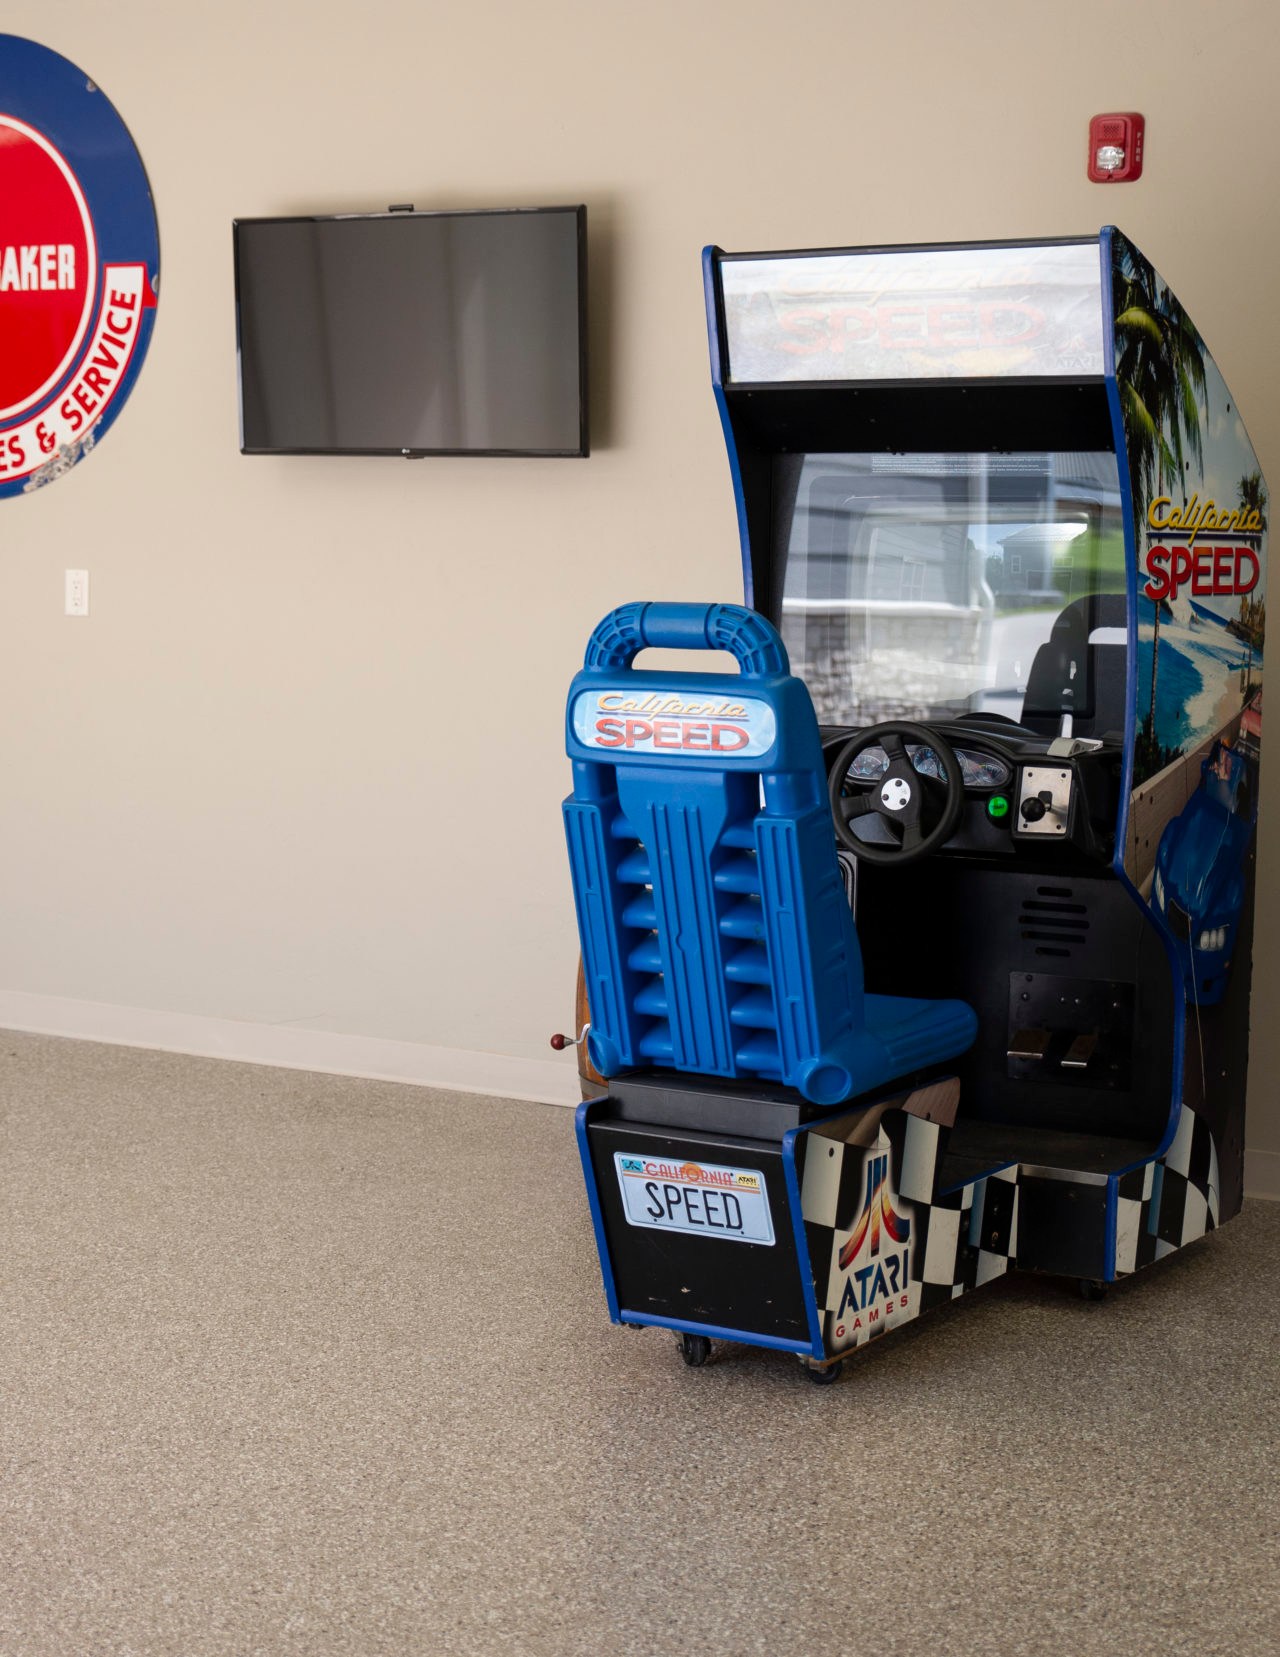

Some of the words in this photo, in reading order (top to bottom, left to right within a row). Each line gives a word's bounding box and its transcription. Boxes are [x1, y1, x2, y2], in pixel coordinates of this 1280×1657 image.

[779, 302, 1045, 355] SPEED
[36, 421, 55, 453] &
[61, 289, 136, 431] SERVICE
[1147, 492, 1262, 546] California
[1144, 545, 1260, 600] SPEED
[598, 693, 748, 721] California
[594, 718, 750, 752] SPEED
[645, 1162, 733, 1185] CALIFORNIA
[645, 1181, 743, 1230] SPEED
[837, 1248, 908, 1320] ATARI
[835, 1295, 908, 1338] GAMES
